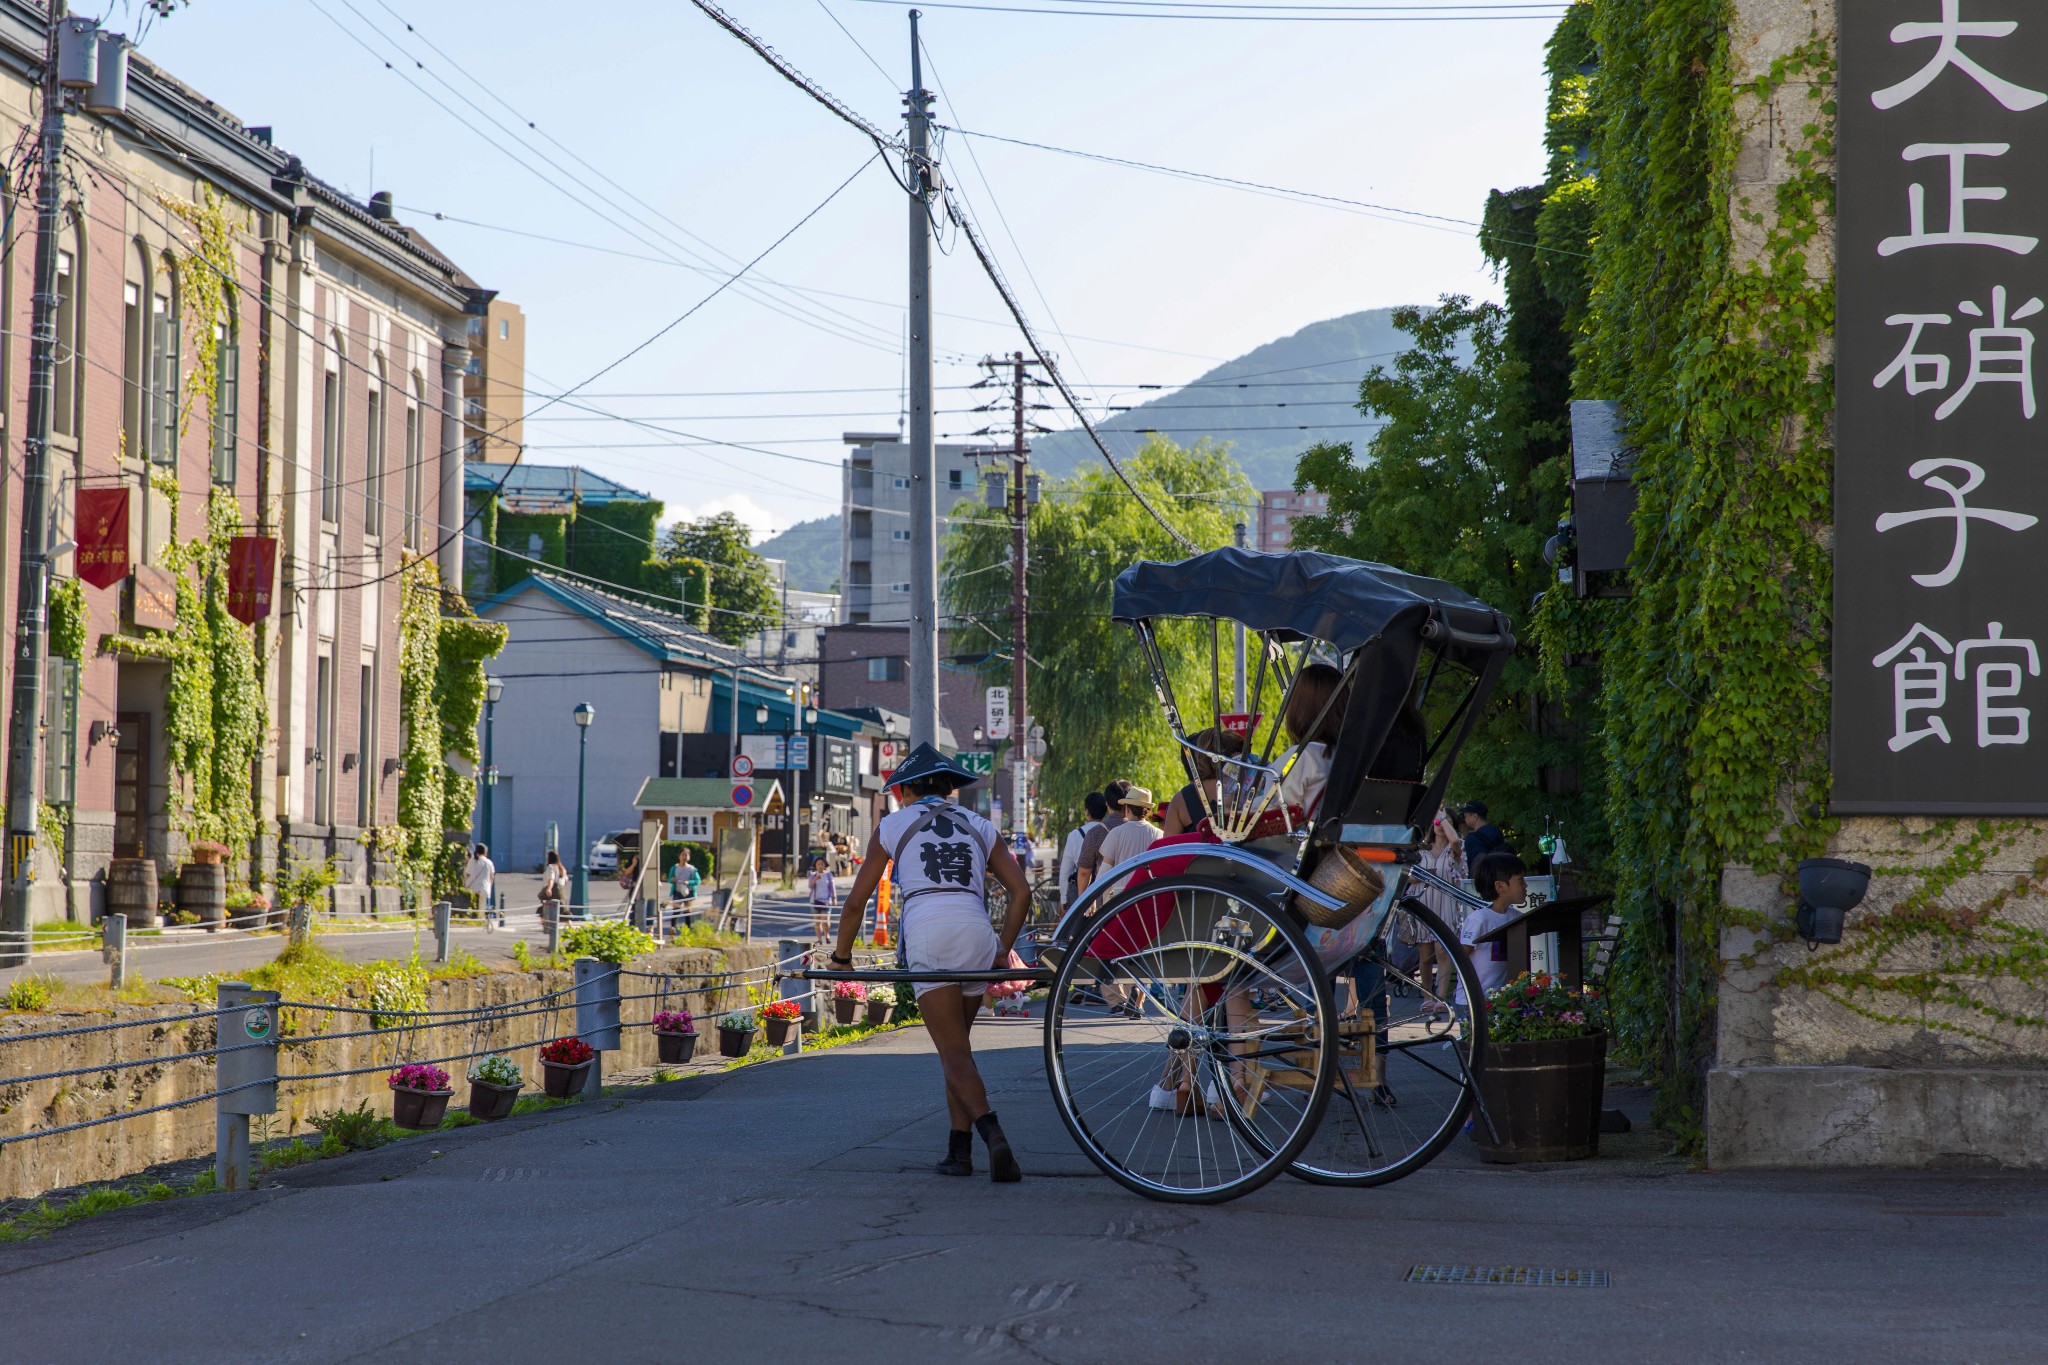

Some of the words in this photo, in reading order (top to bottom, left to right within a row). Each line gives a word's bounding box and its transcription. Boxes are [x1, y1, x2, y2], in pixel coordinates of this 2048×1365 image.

[1870, 0, 2048, 752] 大正硝子館
[991, 689, 1005, 726] 北一硝子
[737, 760, 749, 770] 30
